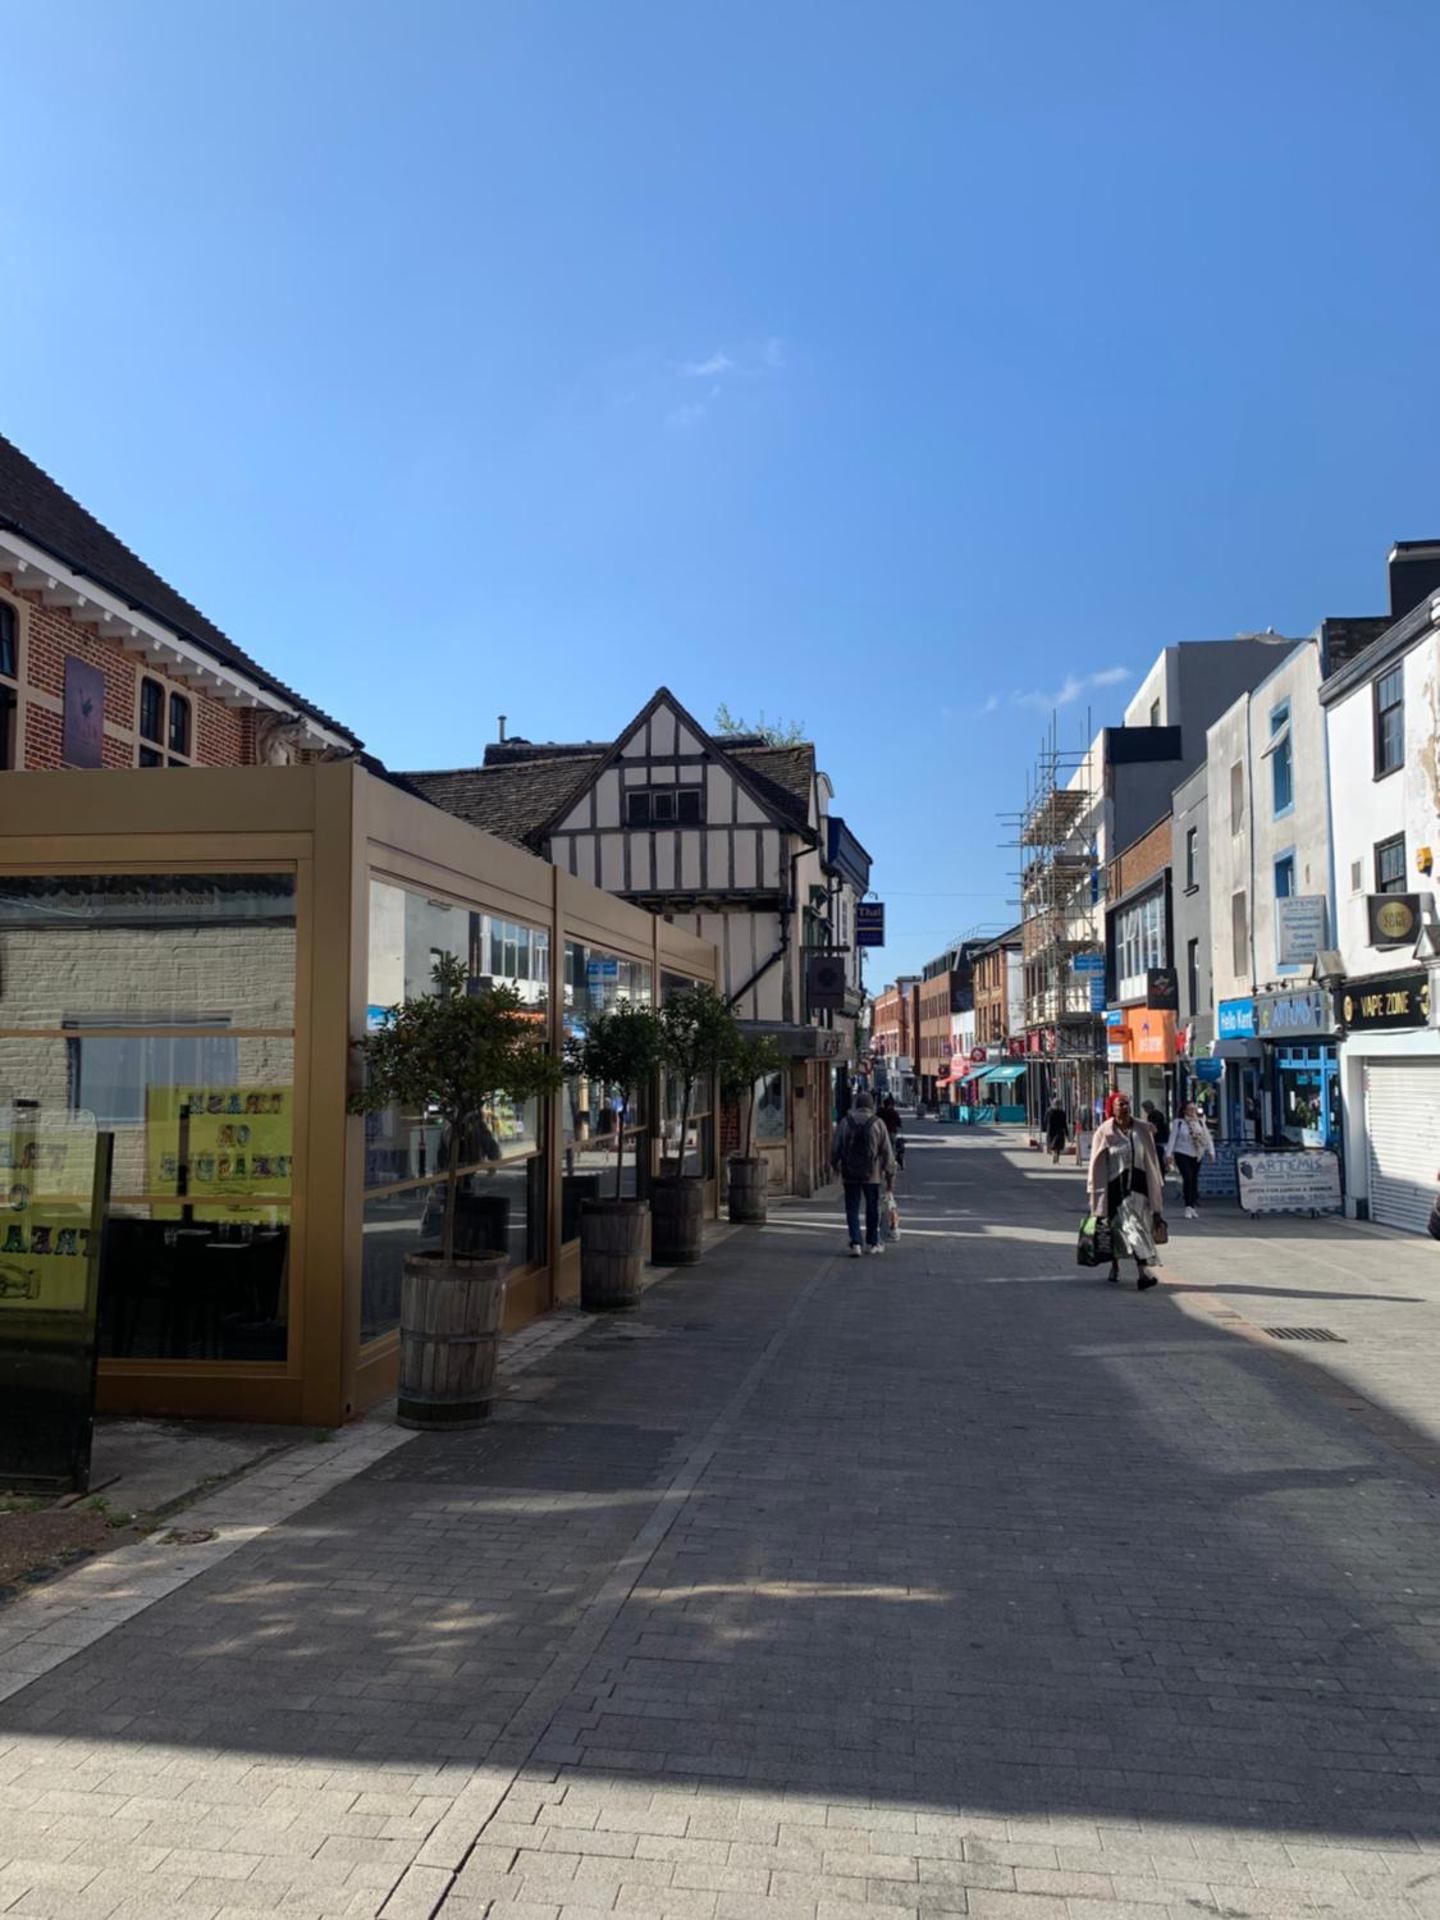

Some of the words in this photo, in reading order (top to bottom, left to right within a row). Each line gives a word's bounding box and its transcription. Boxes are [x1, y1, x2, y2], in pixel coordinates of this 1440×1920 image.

[1360, 994, 1384, 1017] VAPE
[1385, 991, 1410, 1015] ZONE
[1256, 1159, 1322, 1174] ARTEMIS
